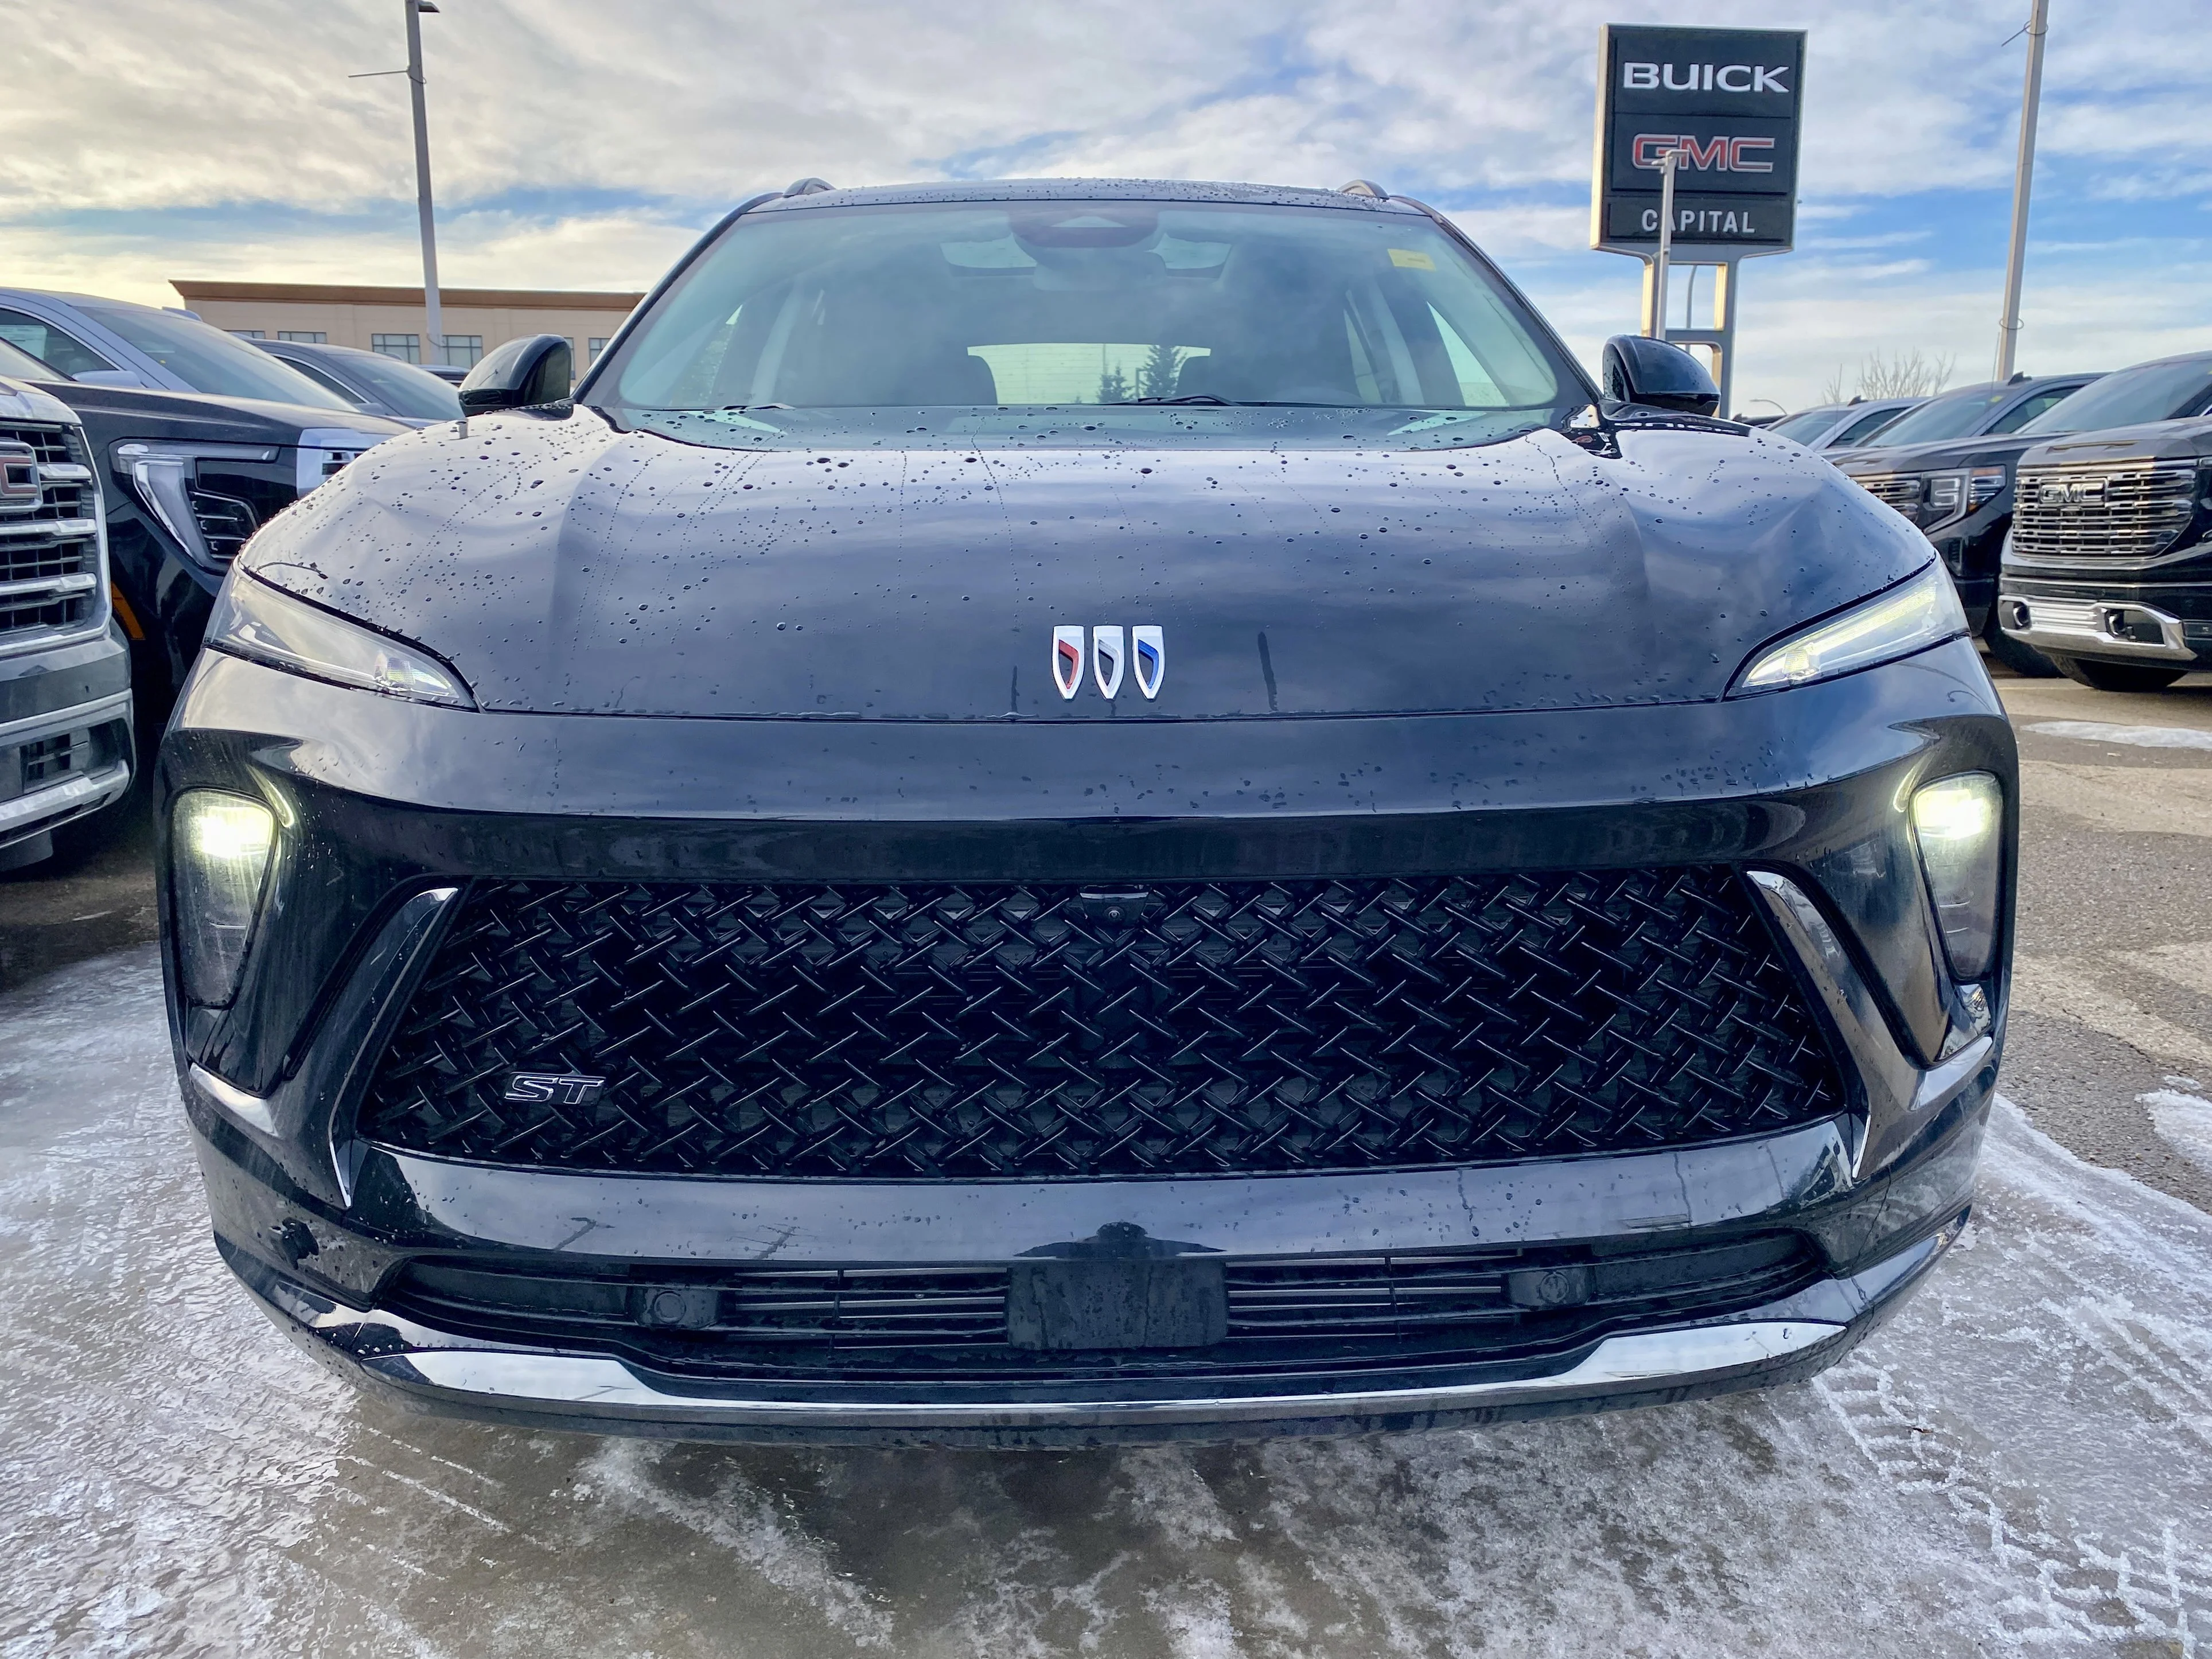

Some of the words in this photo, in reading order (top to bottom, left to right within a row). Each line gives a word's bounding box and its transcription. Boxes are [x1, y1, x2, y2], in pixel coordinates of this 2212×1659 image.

[1623, 62, 1789, 93] BUICK
[1632, 133, 1775, 172] GMC
[1642, 209, 1755, 233] CPITAL
[2040, 482, 2104, 503] GMC
[504, 1074, 605, 1104] ST
